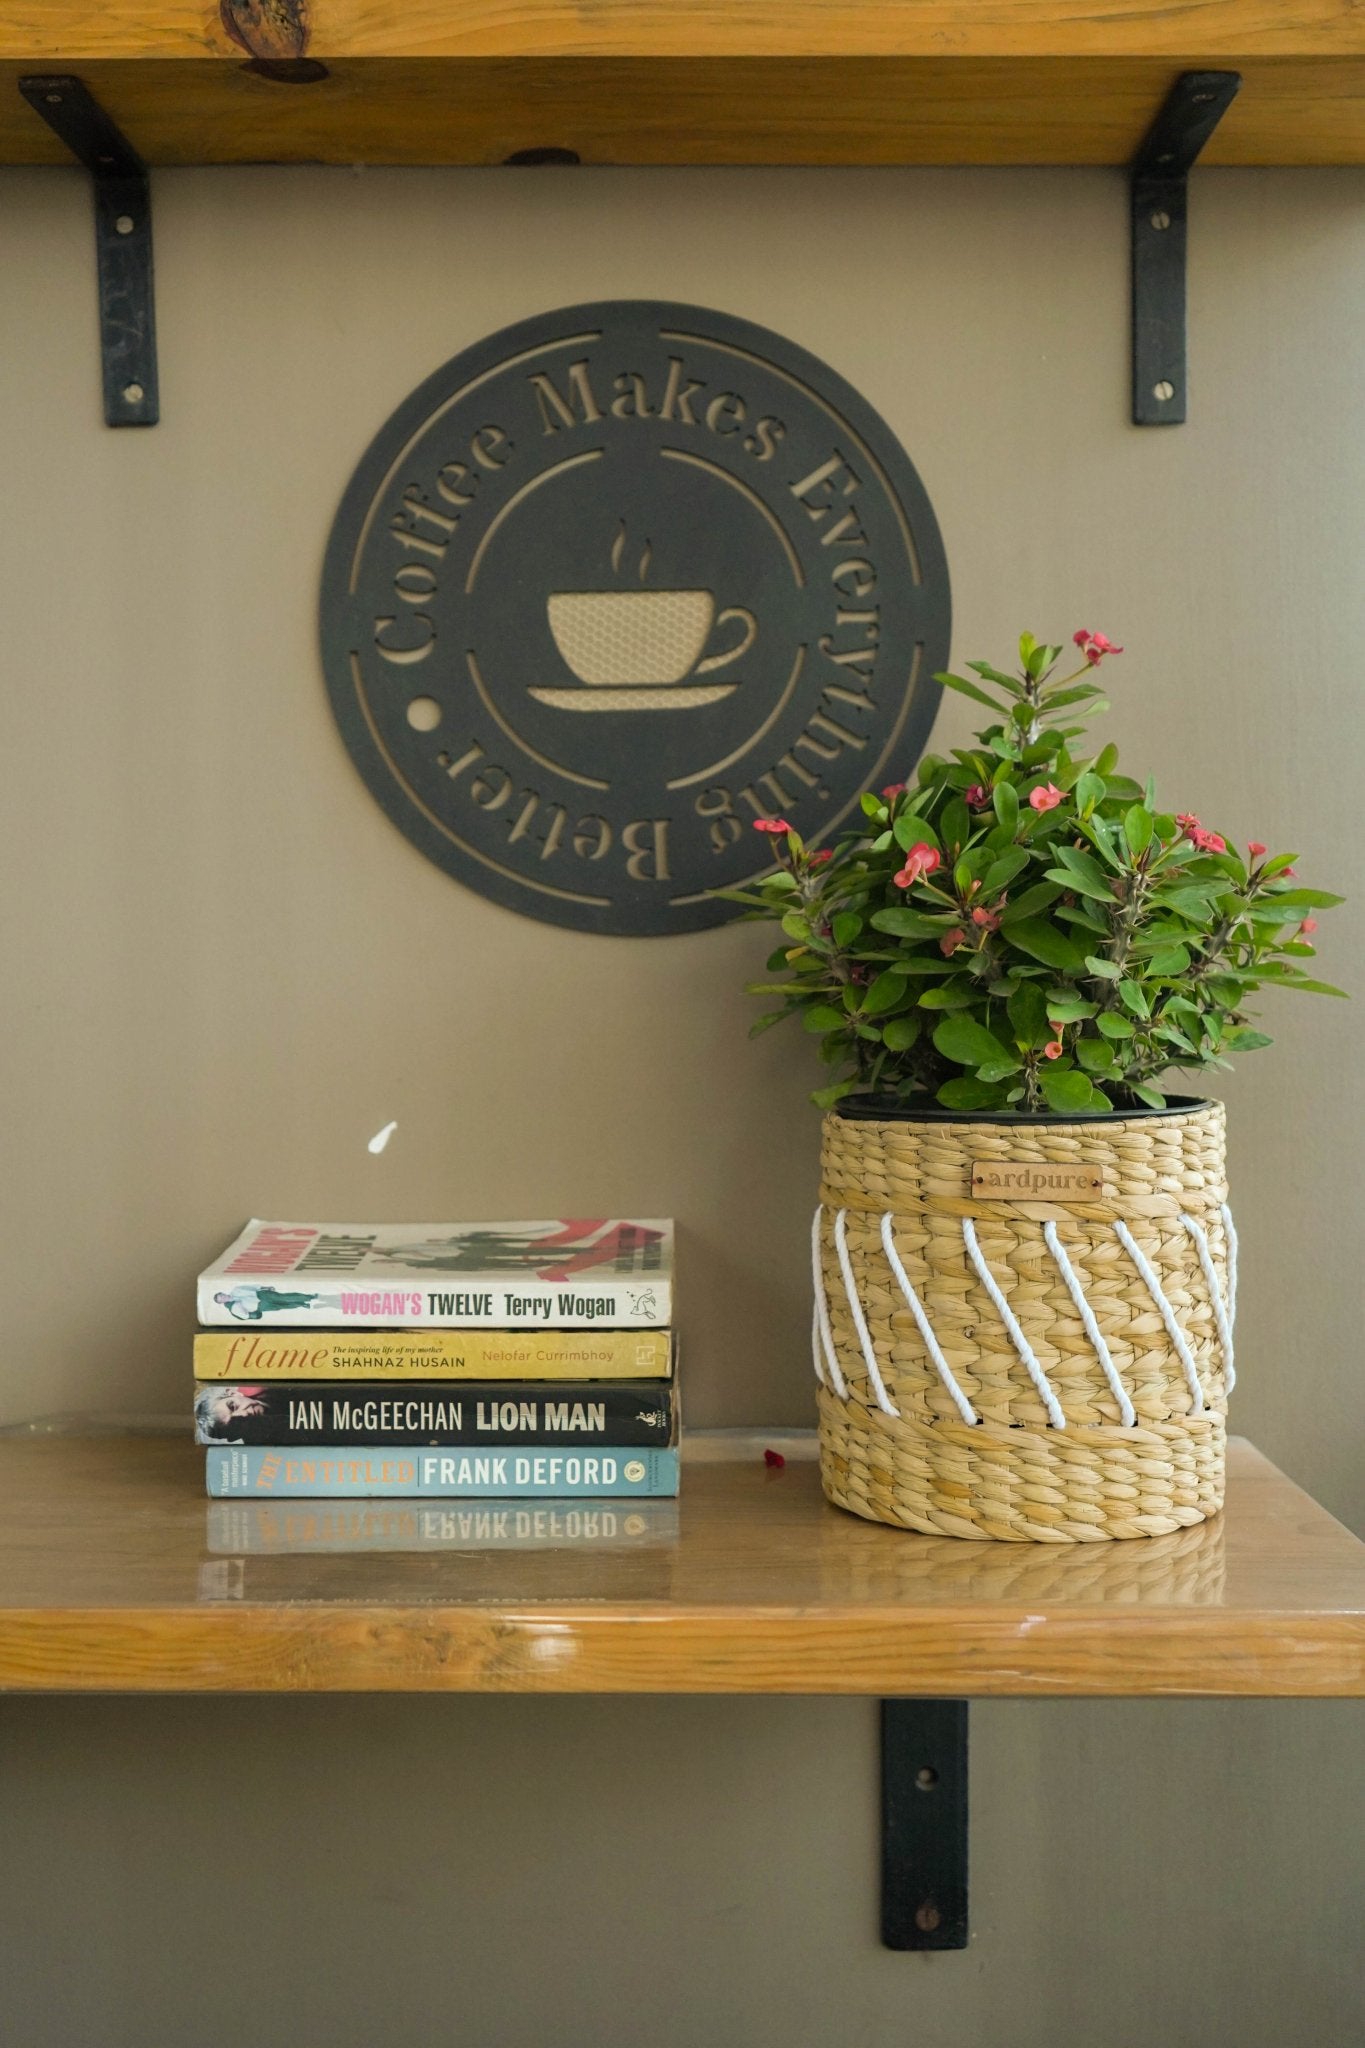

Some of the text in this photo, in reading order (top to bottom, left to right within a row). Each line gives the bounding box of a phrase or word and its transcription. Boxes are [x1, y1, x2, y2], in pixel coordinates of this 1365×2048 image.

[374, 357, 880, 880] Coffee Makes Everything Better
[988, 1168, 1089, 1194] ardpure
[341, 1293, 616, 1319] WOGAN'S TWELVE Terry Wogan
[218, 1336, 328, 1376] flame
[333, 1357, 465, 1367] SHAHNAZ HUSAIN
[347, 1346, 380, 1354] inspiring
[382, 1346, 393, 1354] life
[396, 1346, 404, 1354] of
[482, 1349, 614, 1363] Nelofar Currimbhoy
[289, 1401, 462, 1431] IAN McGEECHAN
[476, 1402, 605, 1431] LION MAN
[256, 1452, 282, 1488] THE
[285, 1460, 414, 1484] ENTITLED
[424, 1457, 507, 1485] FRANK
[515, 1457, 618, 1486] DEFORD
